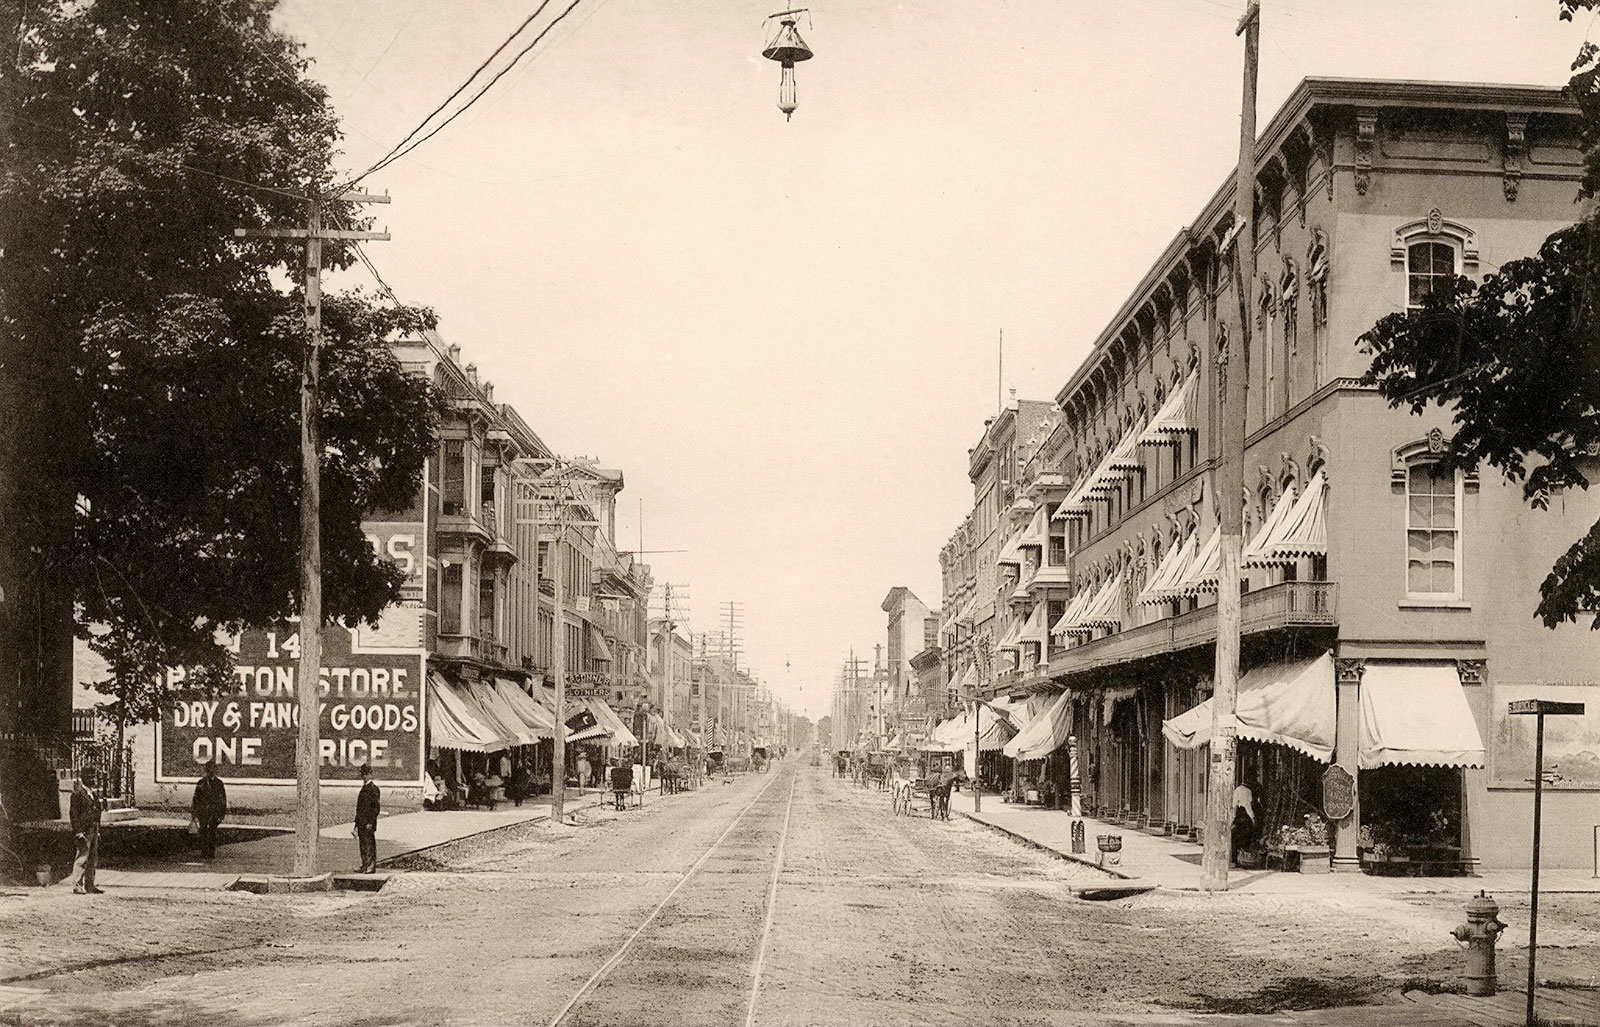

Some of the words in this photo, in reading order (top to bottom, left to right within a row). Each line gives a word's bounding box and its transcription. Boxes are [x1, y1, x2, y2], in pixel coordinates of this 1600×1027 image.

[266, 632, 323, 659] 14
[565, 689, 610, 697] CLOTHIERS
[174, 701, 219, 728] DRY
[222, 701, 241, 733] &
[331, 703, 418, 733] GOODS
[193, 736, 262, 765] ONE
[295, 738, 403, 768] RICE.
